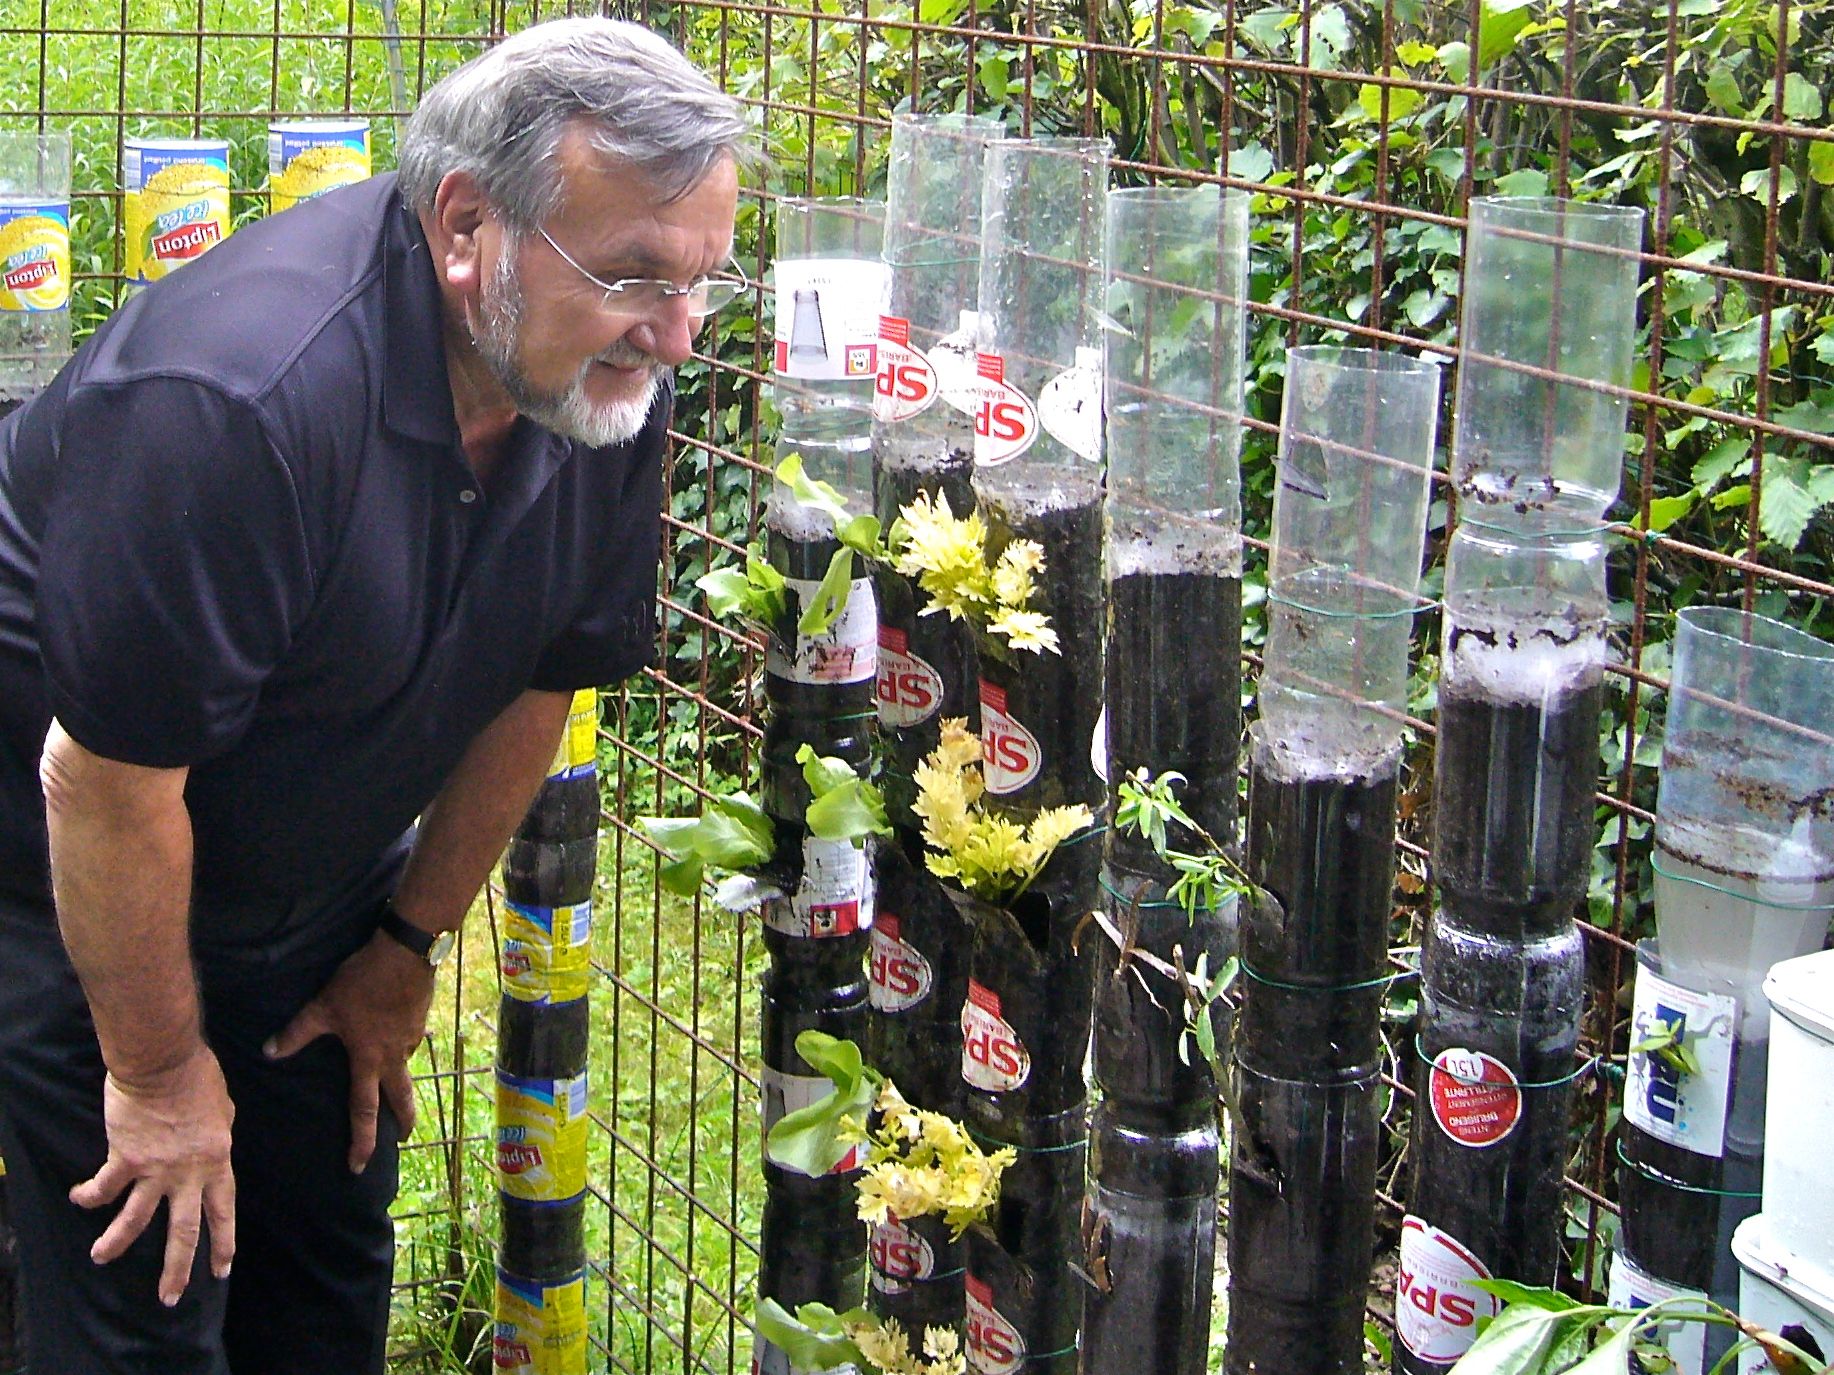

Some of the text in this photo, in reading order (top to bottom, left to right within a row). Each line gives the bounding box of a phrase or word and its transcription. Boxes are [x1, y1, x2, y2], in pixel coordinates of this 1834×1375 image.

[158, 200, 209, 230] Ice Tea
[159, 223, 218, 254] Lipton
[8, 262, 55, 287] Lipton
[1399, 1265, 1475, 1327] SPA
